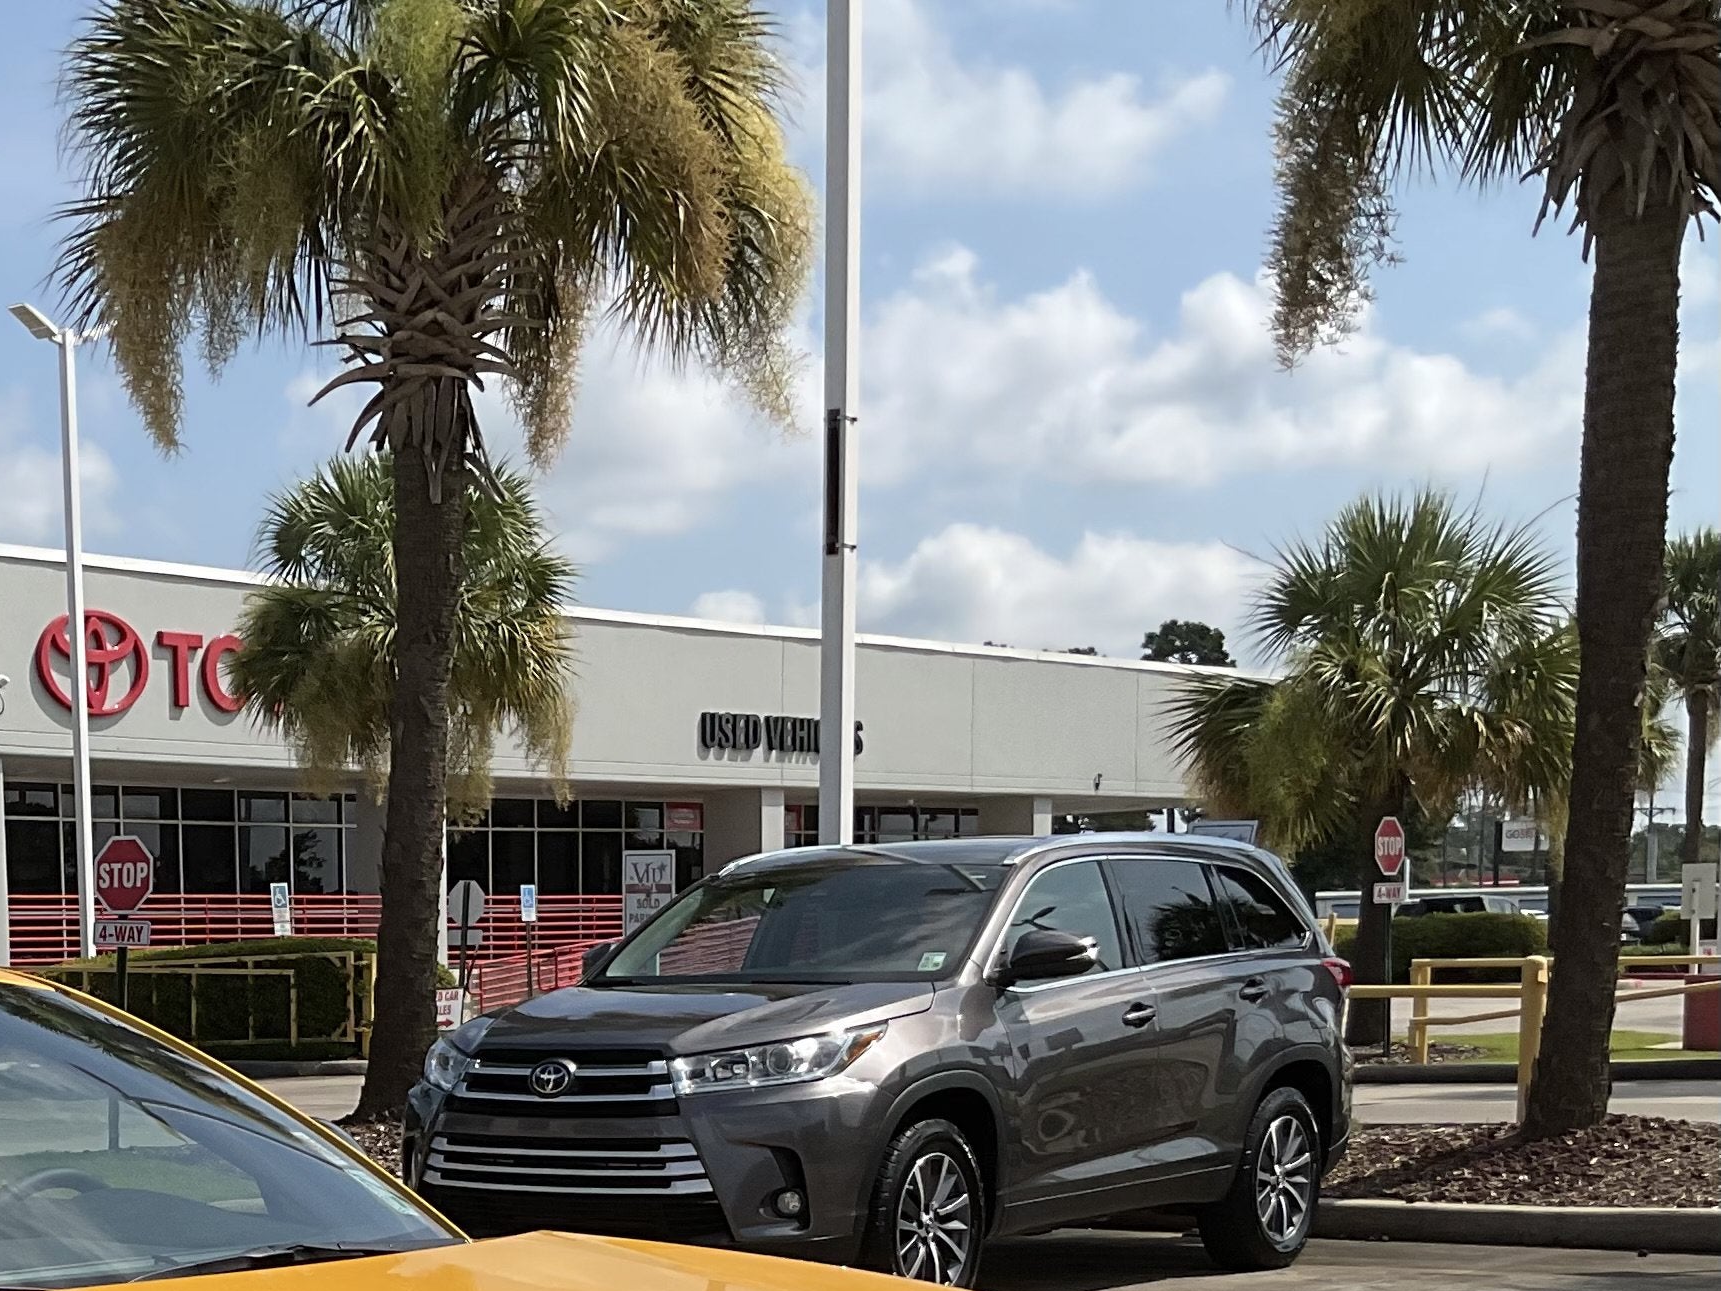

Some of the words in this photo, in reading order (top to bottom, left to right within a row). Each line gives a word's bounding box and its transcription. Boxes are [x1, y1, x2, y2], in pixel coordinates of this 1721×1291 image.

[700, 712, 762, 750] USED
[764, 715, 864, 755] VEHIS
[1378, 836, 1402, 856] STOP
[98, 862, 148, 888] STOP
[1376, 886, 1402, 899] 4-WAY
[636, 898, 661, 909] SOLD
[98, 925, 144, 943] 4-WAY
[445, 991, 459, 1001] CAR
[438, 1005, 451, 1015] LES
